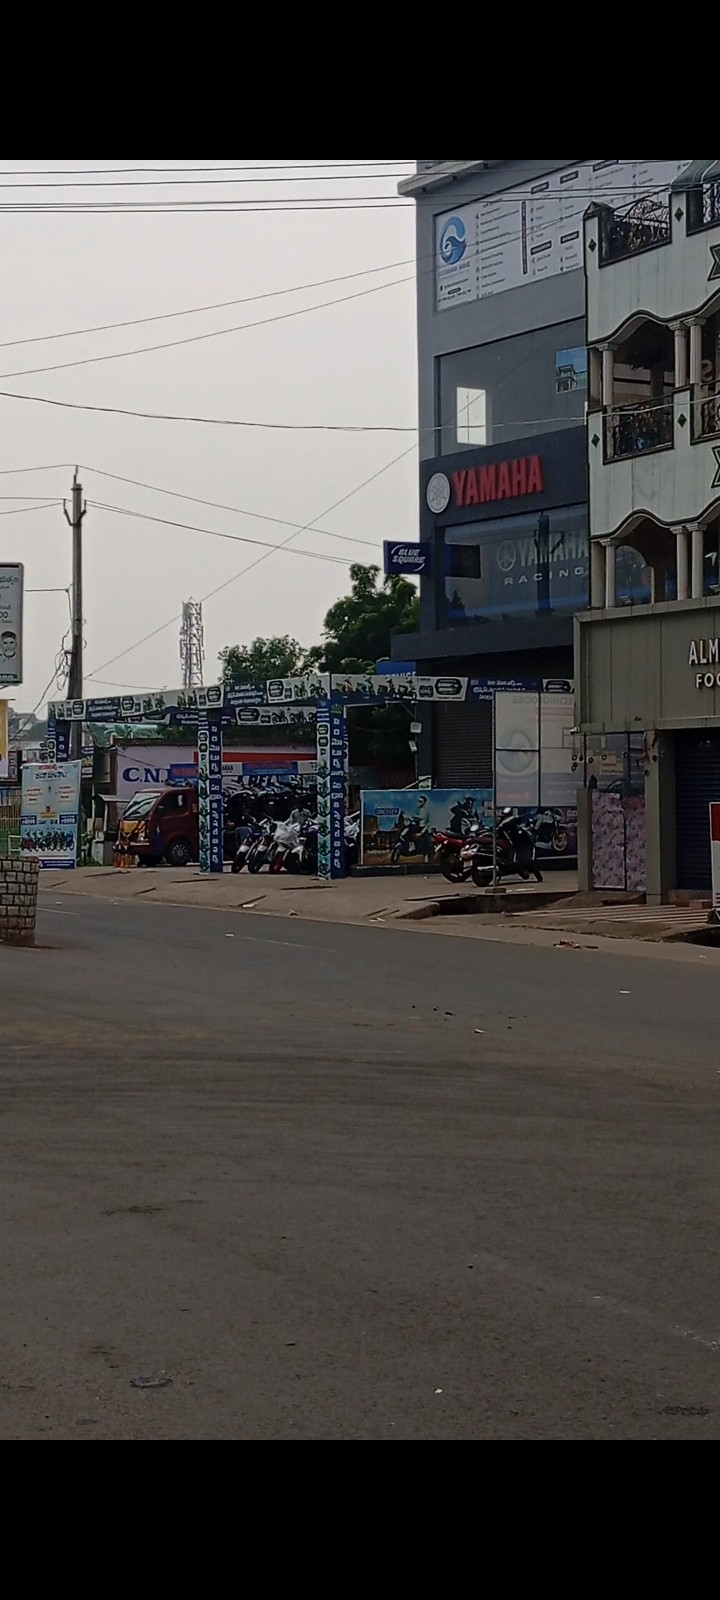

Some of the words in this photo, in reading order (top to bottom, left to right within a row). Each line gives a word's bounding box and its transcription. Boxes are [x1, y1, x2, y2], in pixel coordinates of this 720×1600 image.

[452, 455, 545, 508] YAMAHA
[398, 548, 421, 557] BLUE
[392, 555, 427, 565] SQUARE
[504, 566, 585, 585] RACING
